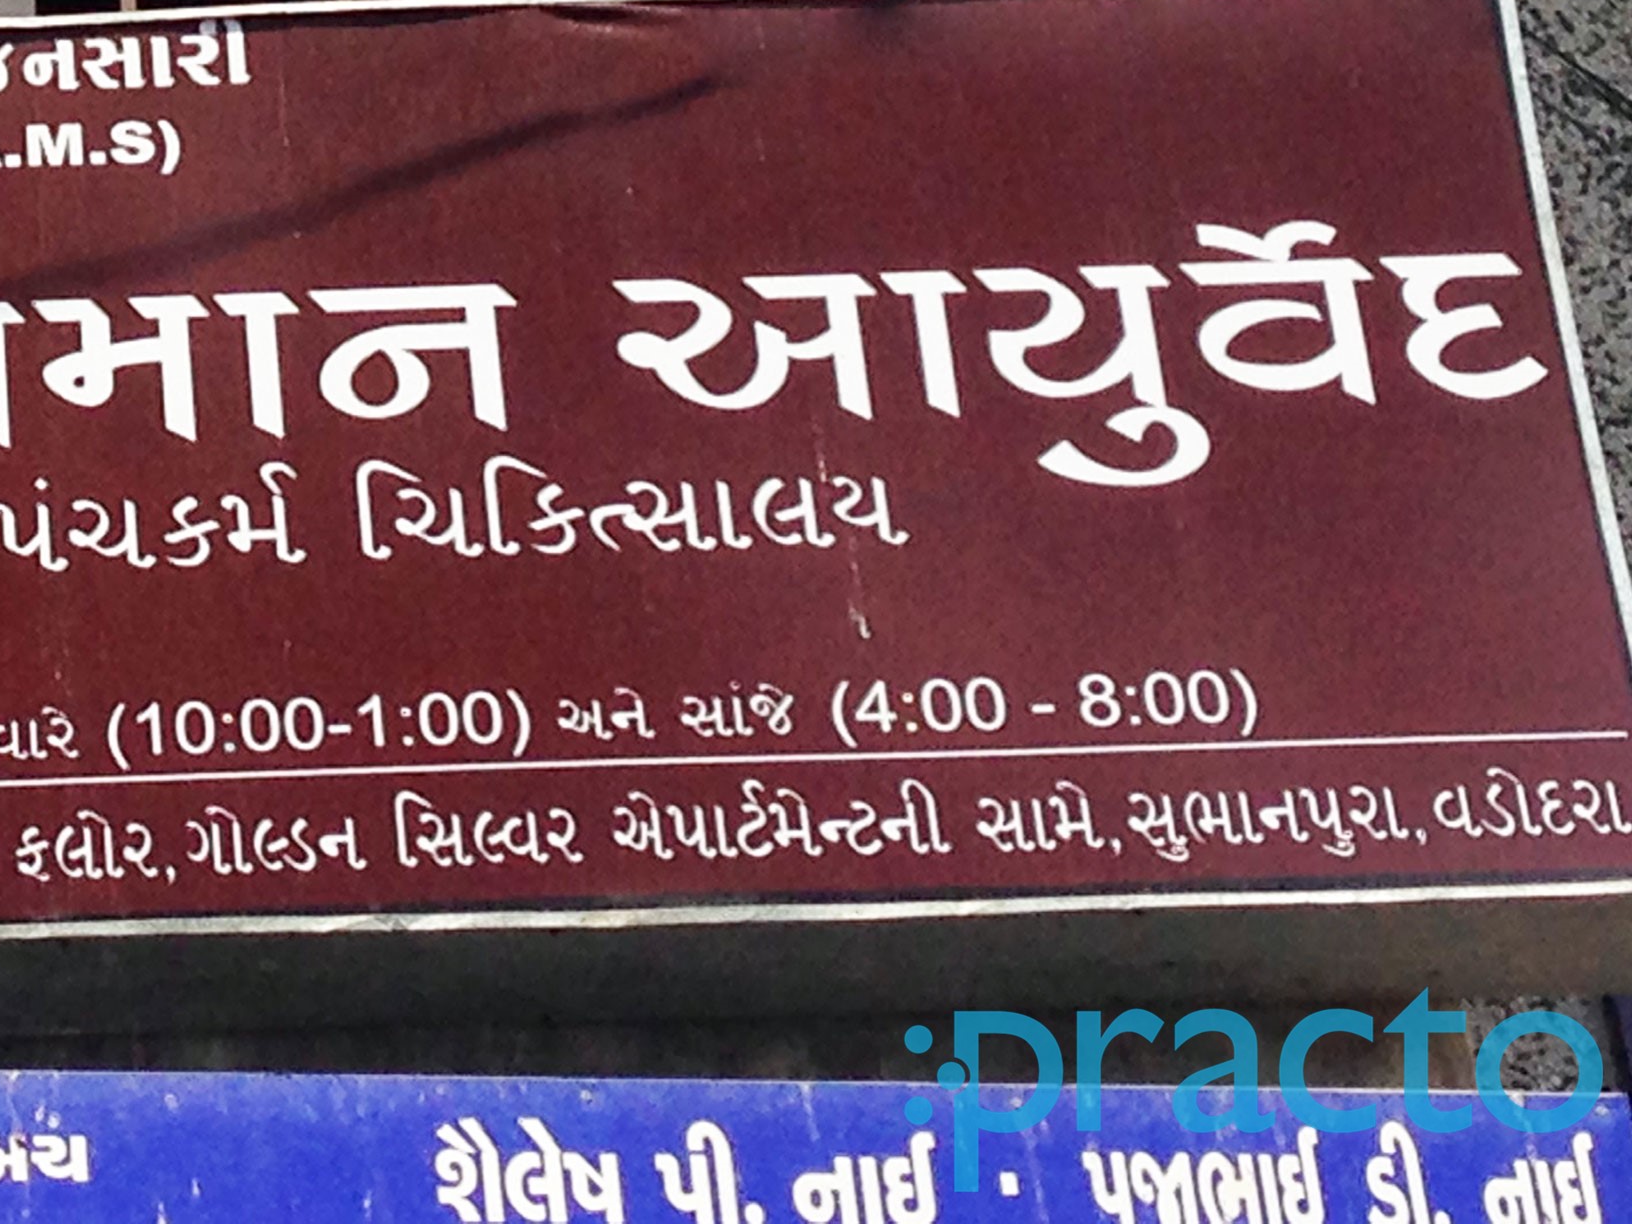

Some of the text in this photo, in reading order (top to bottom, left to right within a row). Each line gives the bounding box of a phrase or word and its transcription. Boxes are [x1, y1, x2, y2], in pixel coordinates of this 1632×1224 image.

[611, 218, 1550, 489] આયુર્વેદ
[354, 455, 911, 560] ચિકિત્સાલય
[106, 688, 533, 770] (10:00-1:00)
[556, 686, 657, 741] અને
[679, 680, 795, 739] સાંજે
[830, 675, 1008, 749] (4:00
[1077, 667, 1259, 738] 8:00)
[184, 804, 369, 876] ગોલ્ડન
[393, 789, 585, 869] સિલ્વર
[612, 777, 953, 861] એપાર્ટમેન્ટની
[975, 779, 1123, 856] સામે,
[1430, 764, 1632, 838] વડોદરા
[434, 1116, 625, 1224] શૈલેષ
[792, 1131, 938, 1224] નાઈ
